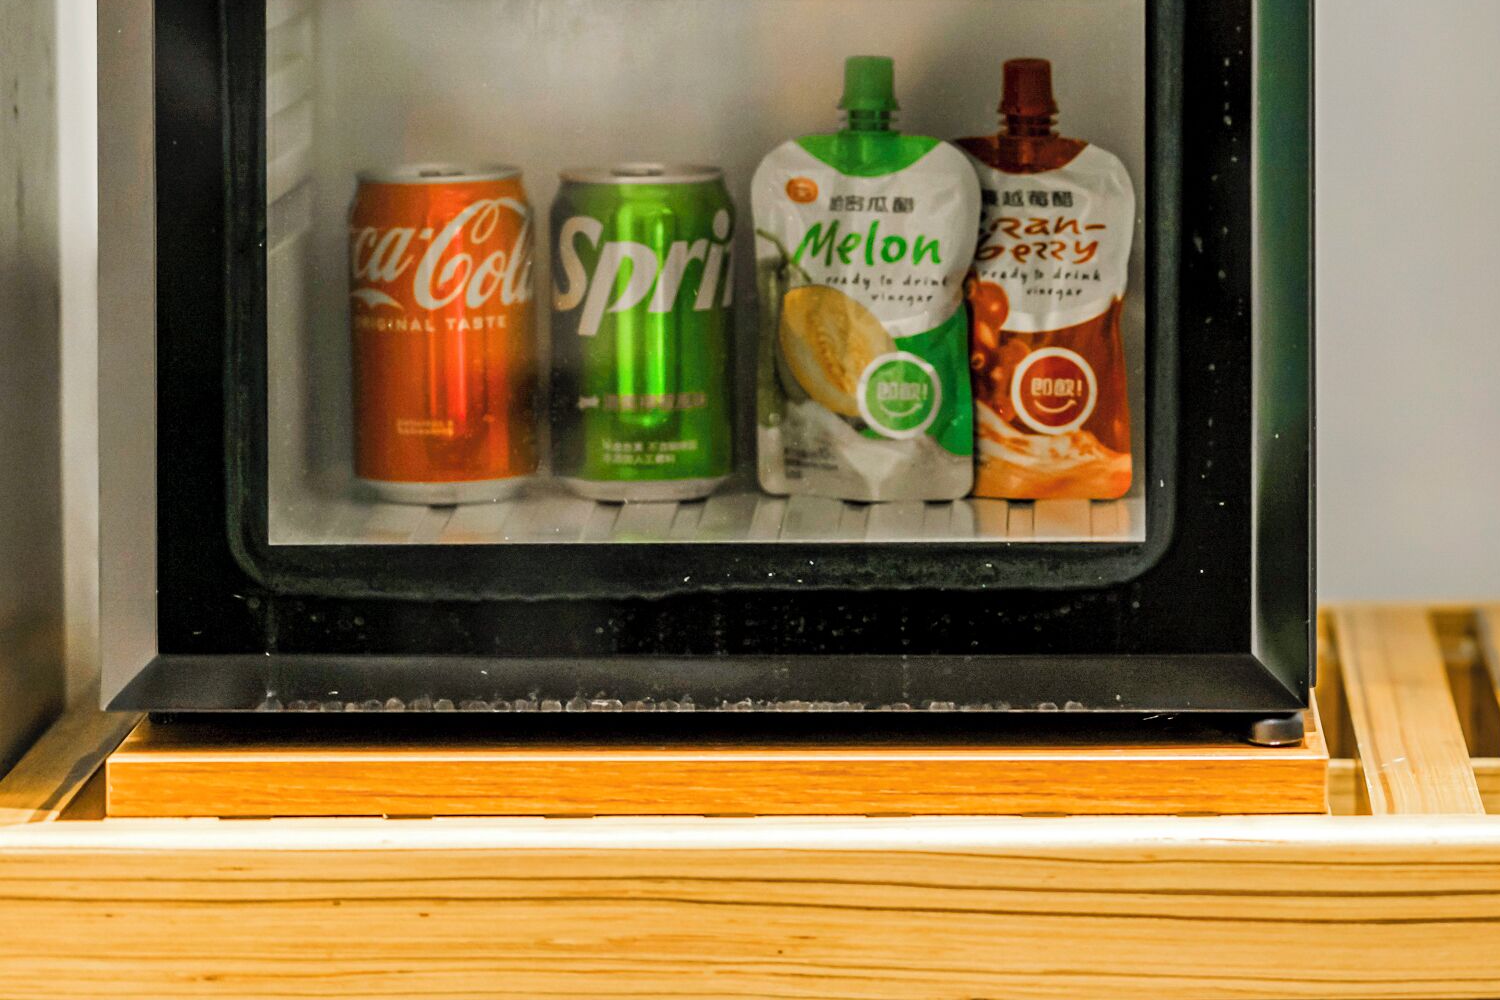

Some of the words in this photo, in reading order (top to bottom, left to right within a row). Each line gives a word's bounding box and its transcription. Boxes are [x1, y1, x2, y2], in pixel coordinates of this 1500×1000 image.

[790, 219, 942, 268] Melon
[975, 237, 1099, 264] berry
[825, 273, 871, 291] ready
[981, 266, 1028, 285] ready
[1053, 266, 1102, 282] drink
[445, 314, 507, 332] TASTE
